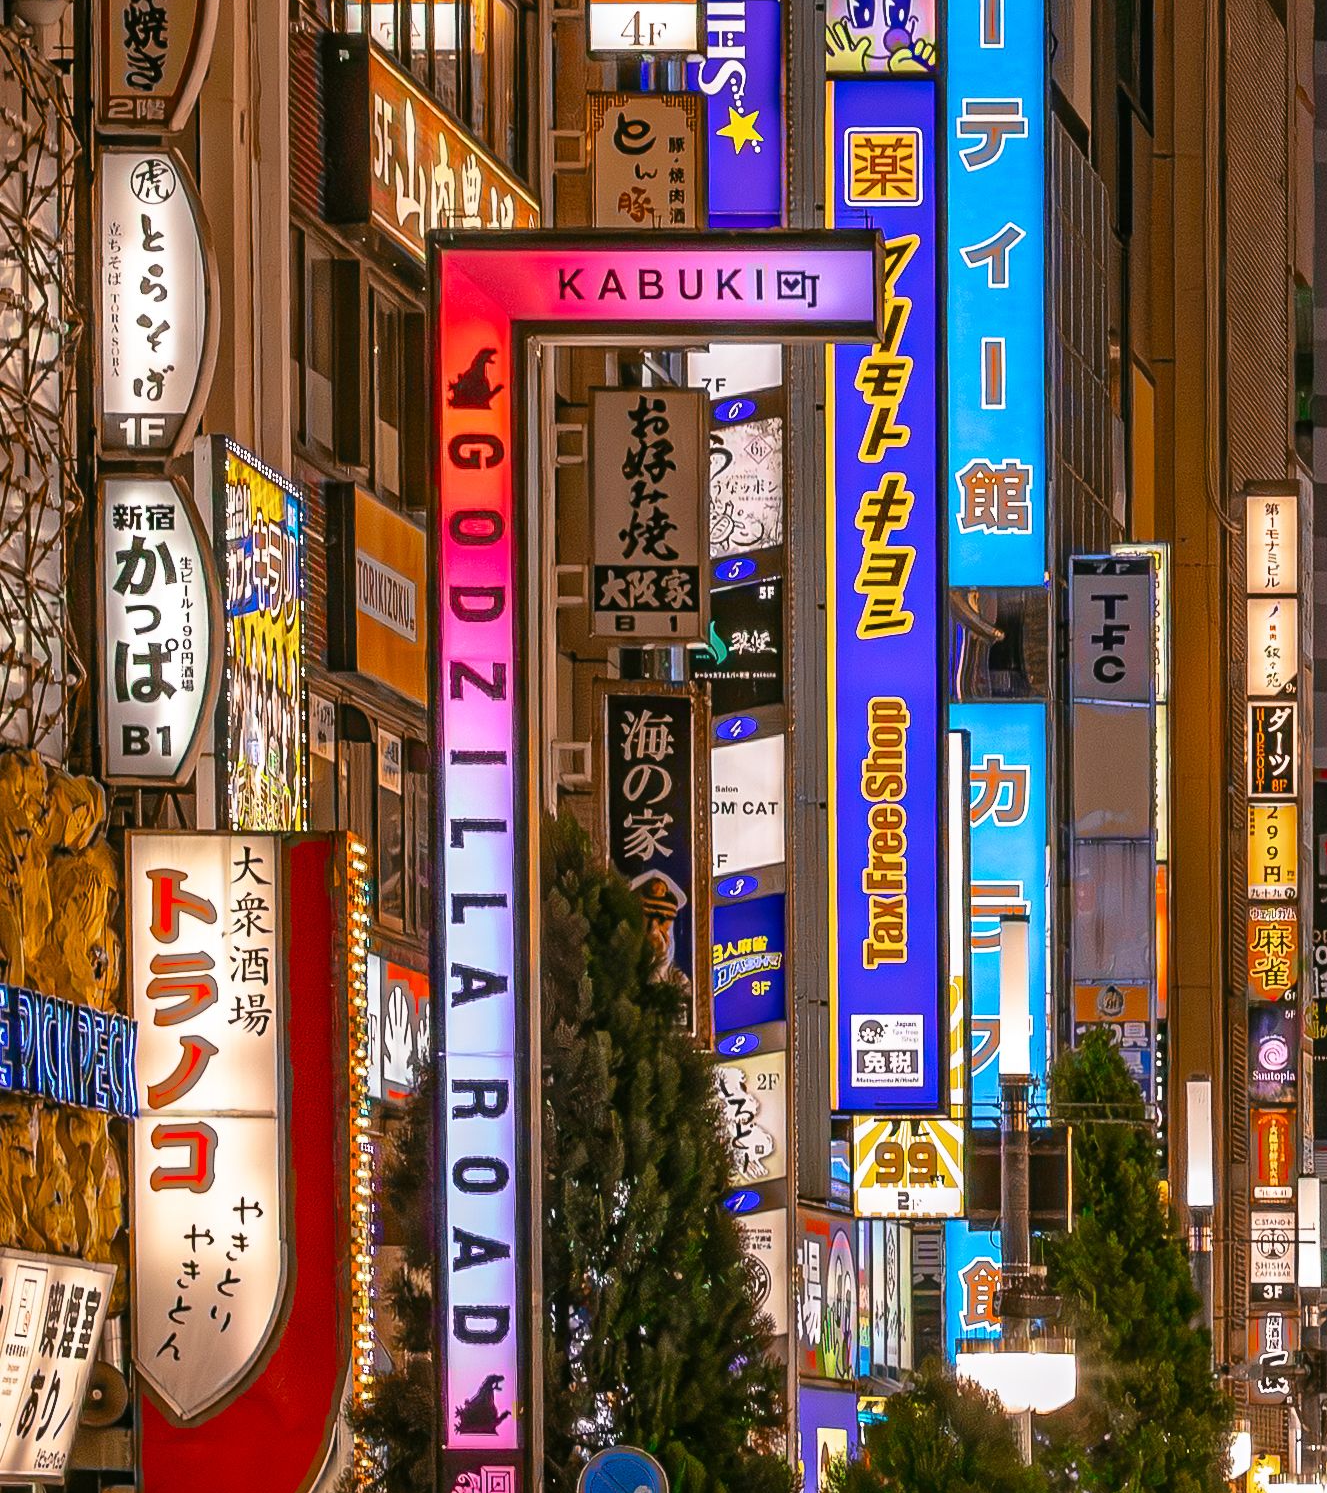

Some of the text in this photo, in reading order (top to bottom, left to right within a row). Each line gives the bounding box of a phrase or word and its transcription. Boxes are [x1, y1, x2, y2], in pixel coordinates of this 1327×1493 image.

[619, 10, 668, 48] 4F
[108, 96, 165, 121] 2階
[373, 94, 393, 185] 5F
[136, 161, 173, 200] 虎
[851, 136, 917, 200] 薬
[134, 214, 175, 402] とらそば
[118, 420, 165, 446] 1F
[619, 395, 682, 561] お好み焼
[112, 503, 175, 533] 新宿
[358, 561, 411, 631] TORIKIZOKU
[600, 572, 694, 609] 大阪家
[759, 586, 775, 600] 5F
[1094, 563, 1129, 574] 7F
[113, 537, 178, 704] かっぱ
[1091, 594, 1130, 684] TFC
[122, 726, 172, 758] B1
[1268, 707, 1292, 777] ダーツ
[620, 710, 674, 861] 海の家
[743, 801, 778, 815] CAT
[1272, 780, 1287, 793] 8F
[862, 697, 912, 969] Tax Free Shop
[448, 433, 511, 1345] GODZILLA ROAD
[229, 847, 274, 1037] 大衆酒場
[1250, 923, 1295, 991] 麻雀
[752, 979, 770, 995] 3F
[79, 1002, 138, 1117] PECK
[146, 868, 218, 1191] トラノコ
[863, 1051, 913, 1074] 免税
[757, 1072, 780, 1090] 2F
[156, 1224, 214, 1362] やきとん
[209, 1197, 263, 1333] やきとり
[1263, 1285, 1282, 1297] 3F
